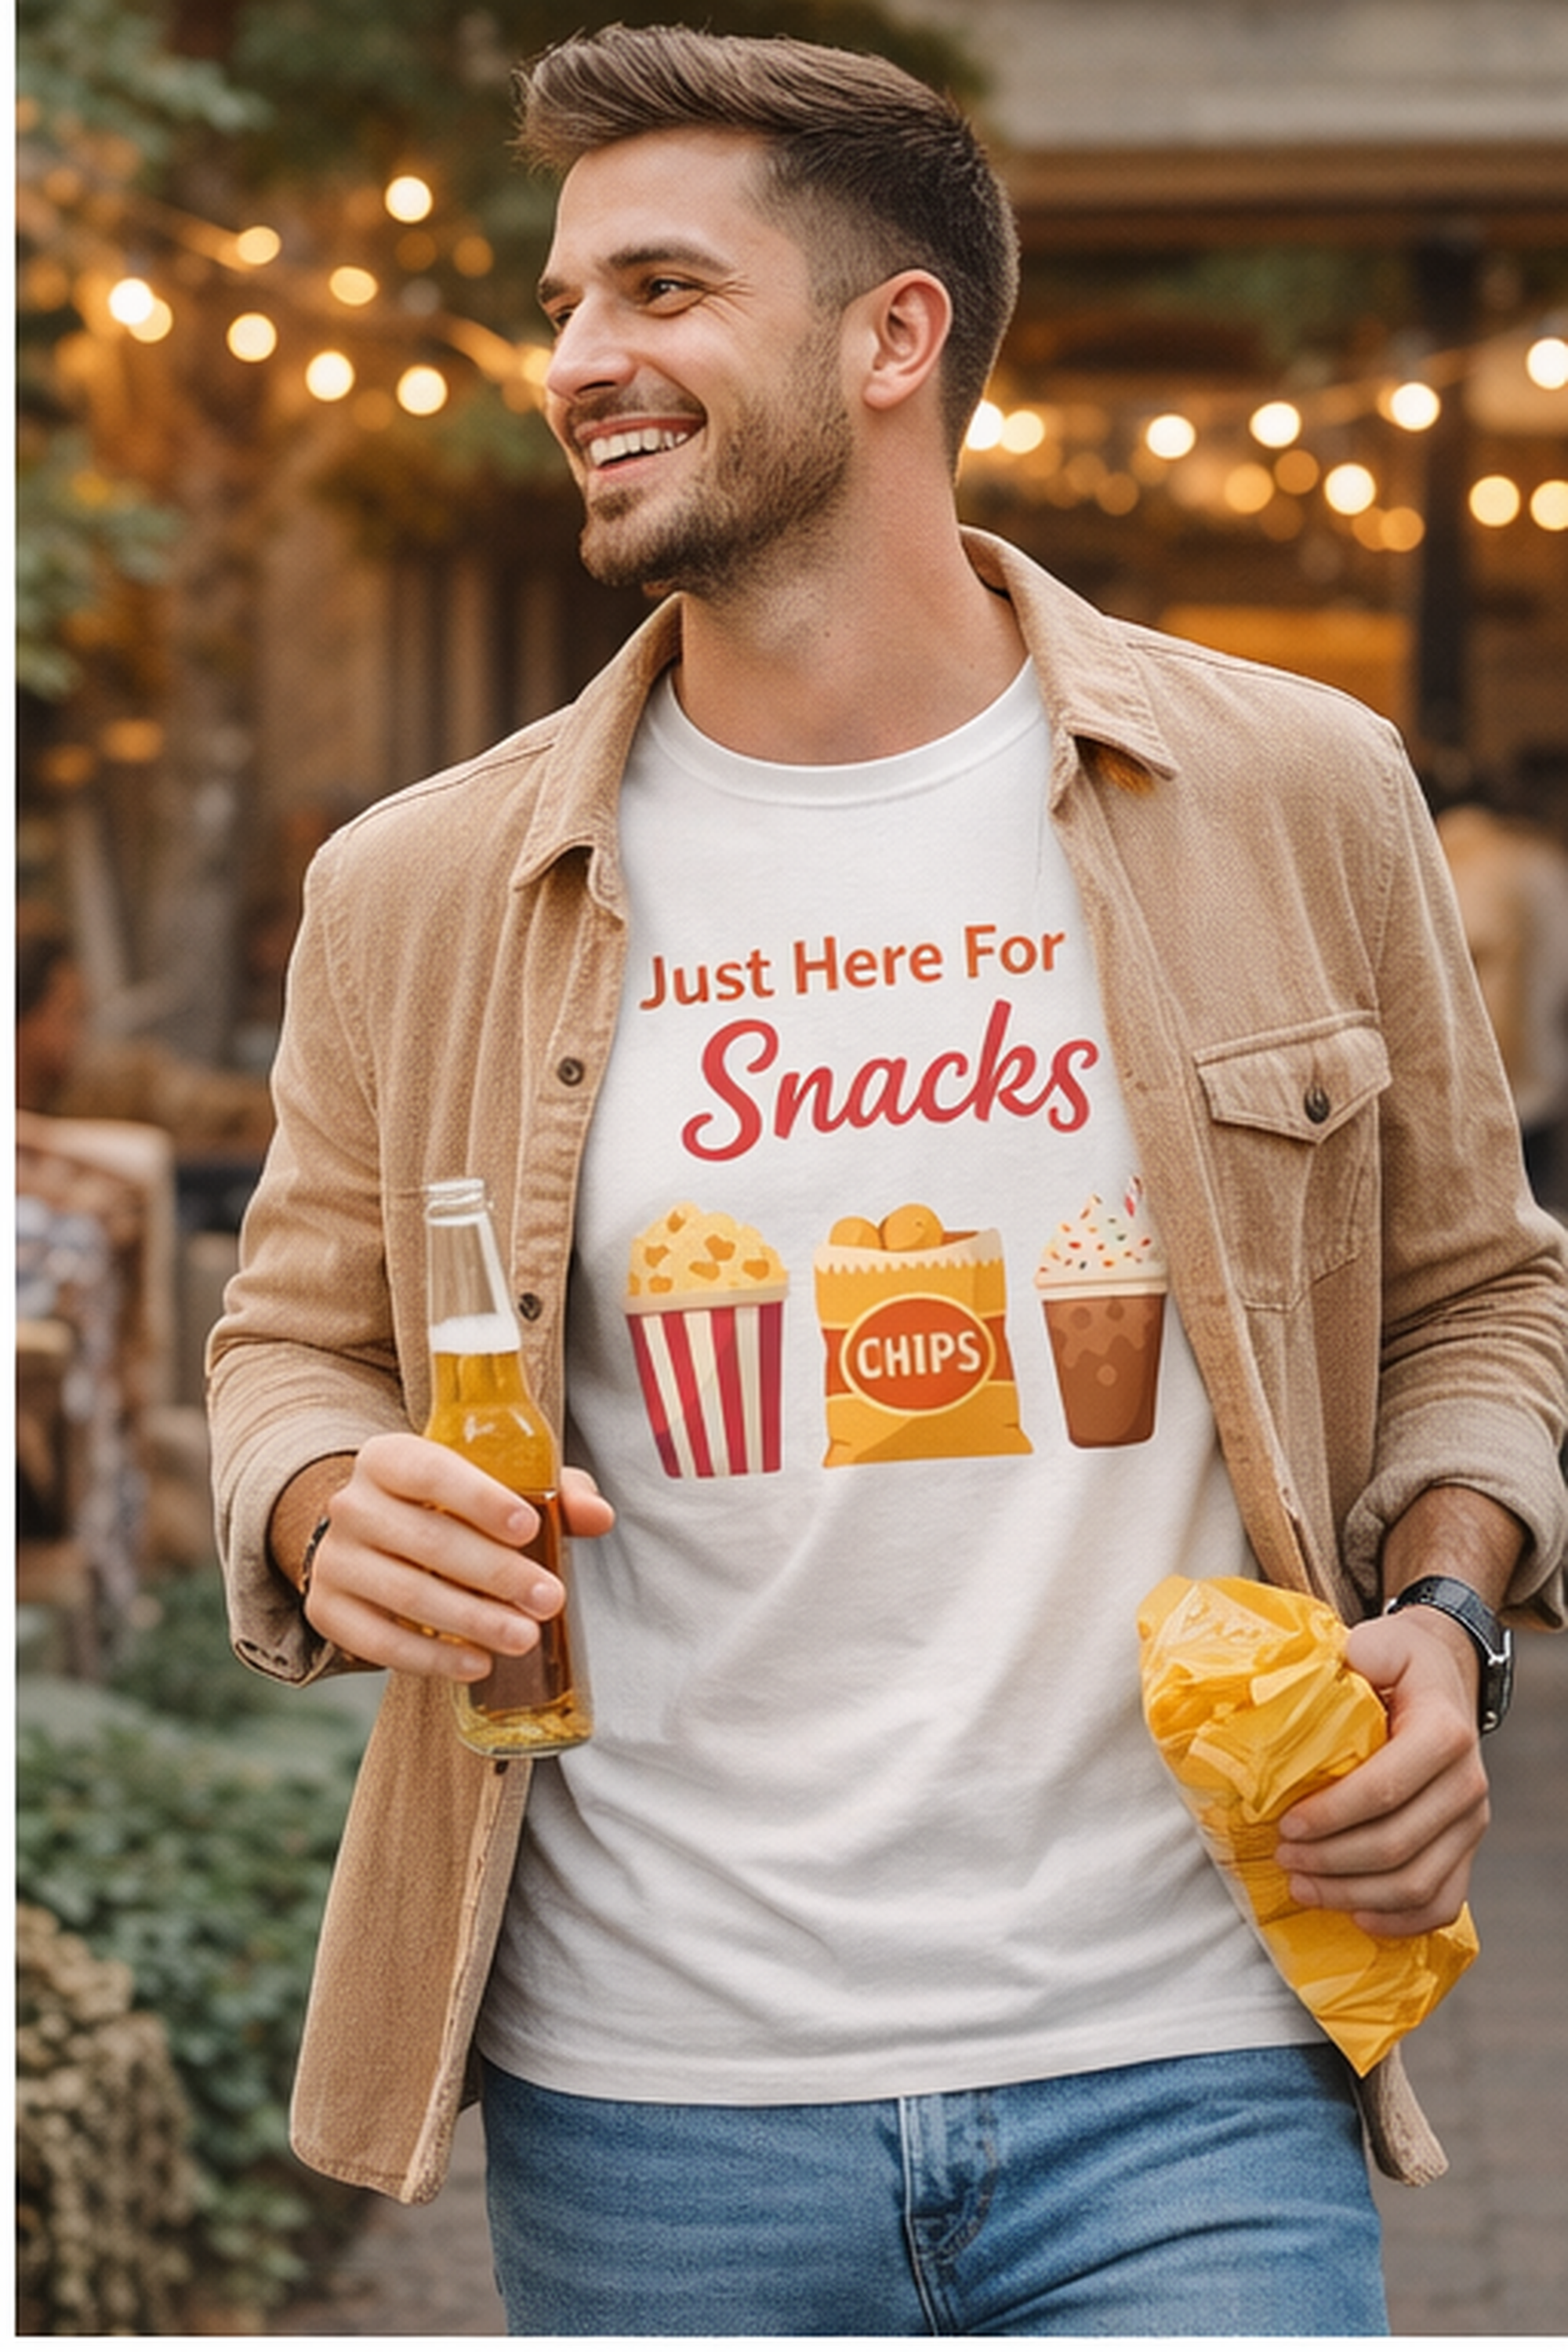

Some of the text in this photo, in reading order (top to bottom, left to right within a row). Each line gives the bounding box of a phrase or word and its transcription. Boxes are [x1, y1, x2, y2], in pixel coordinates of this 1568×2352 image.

[639, 924, 1065, 1011] Just Here For
[681, 999, 1099, 1162] Snacks
[857, 1330, 981, 1379] CHIPS
